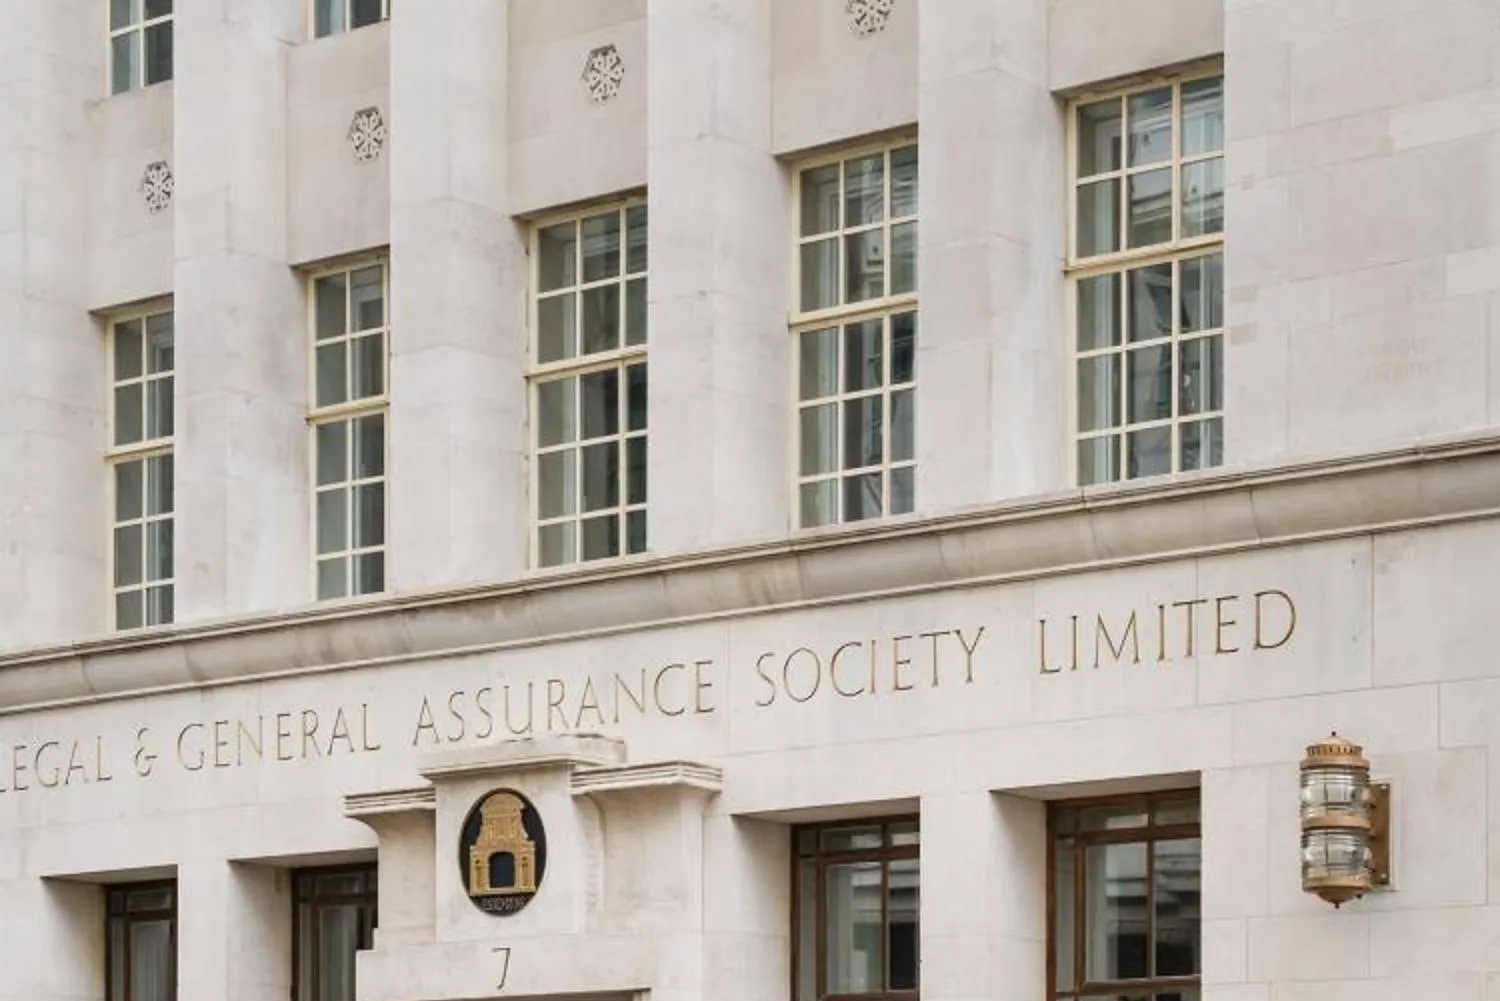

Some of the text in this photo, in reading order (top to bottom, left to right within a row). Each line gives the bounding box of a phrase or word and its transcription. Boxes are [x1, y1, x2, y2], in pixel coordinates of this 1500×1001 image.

[0, 589, 1297, 792] EGAL & GENERAL ASSURANCE SOCIETY LIMITED
[491, 946, 511, 990] 7
